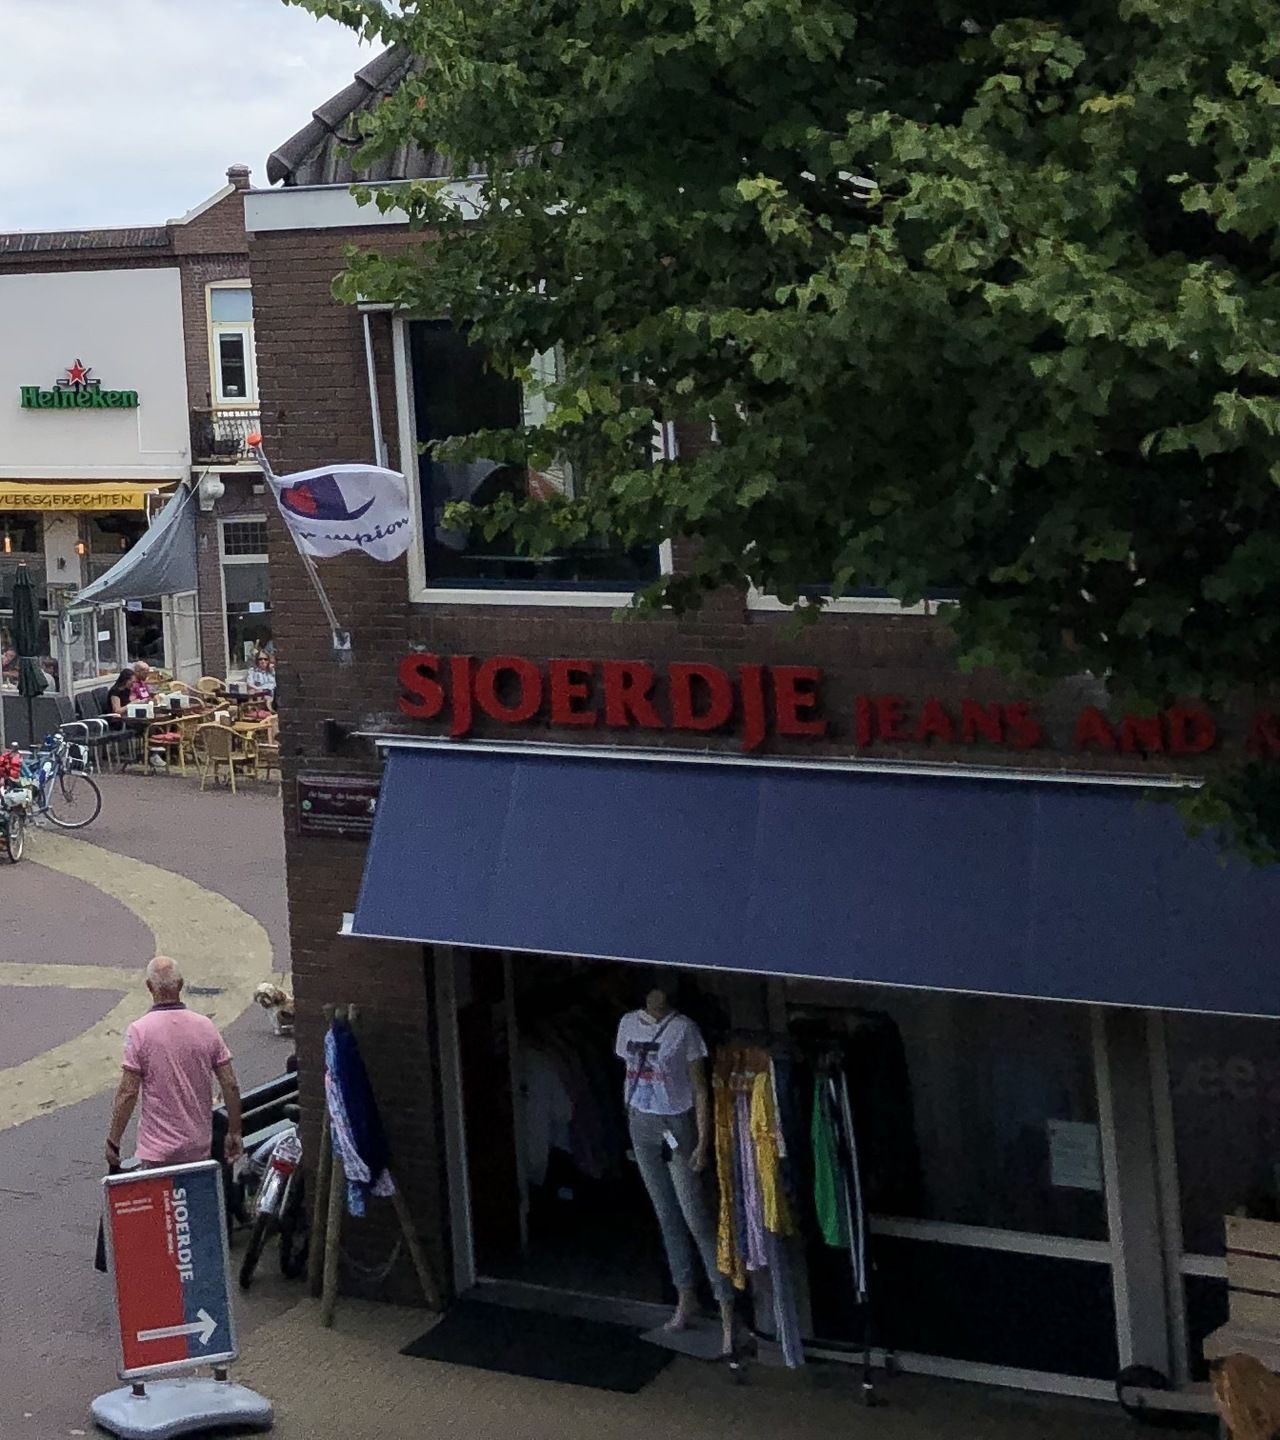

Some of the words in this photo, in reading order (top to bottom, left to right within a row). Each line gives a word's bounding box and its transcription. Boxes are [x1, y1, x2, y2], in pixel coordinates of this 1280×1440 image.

[20, 385, 138, 408] Heineken
[398, 651, 828, 751] SJOERDJE
[854, 693, 1044, 749] JEANS
[1073, 704, 1218, 754] AND
[171, 1187, 194, 1282] SJOERDJE
